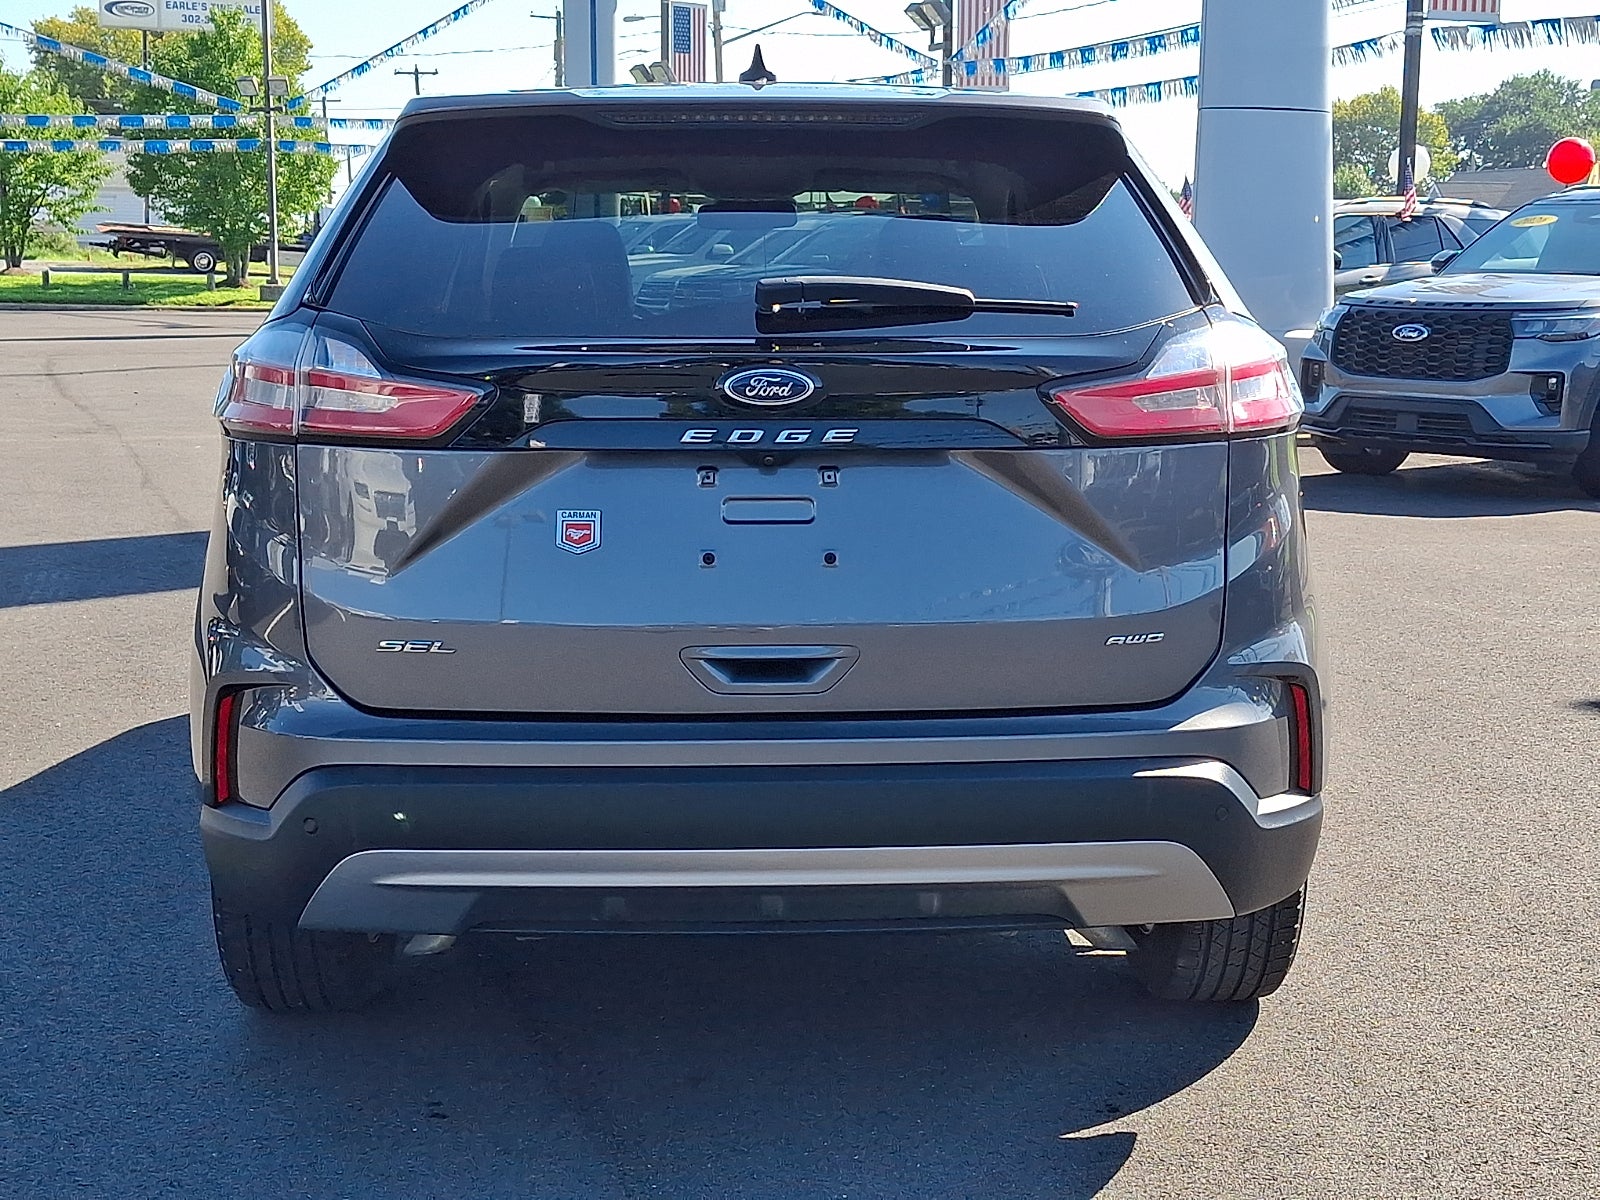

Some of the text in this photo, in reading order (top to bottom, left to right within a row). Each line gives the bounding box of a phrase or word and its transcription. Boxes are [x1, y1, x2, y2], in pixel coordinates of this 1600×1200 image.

[165, 1, 207, 11] EARLE'S
[745, 376, 793, 397] Ford
[680, 428, 859, 443] EDGE
[561, 511, 597, 519] CARMAN
[1104, 632, 1165, 646] AWD
[375, 640, 456, 654] SEL
